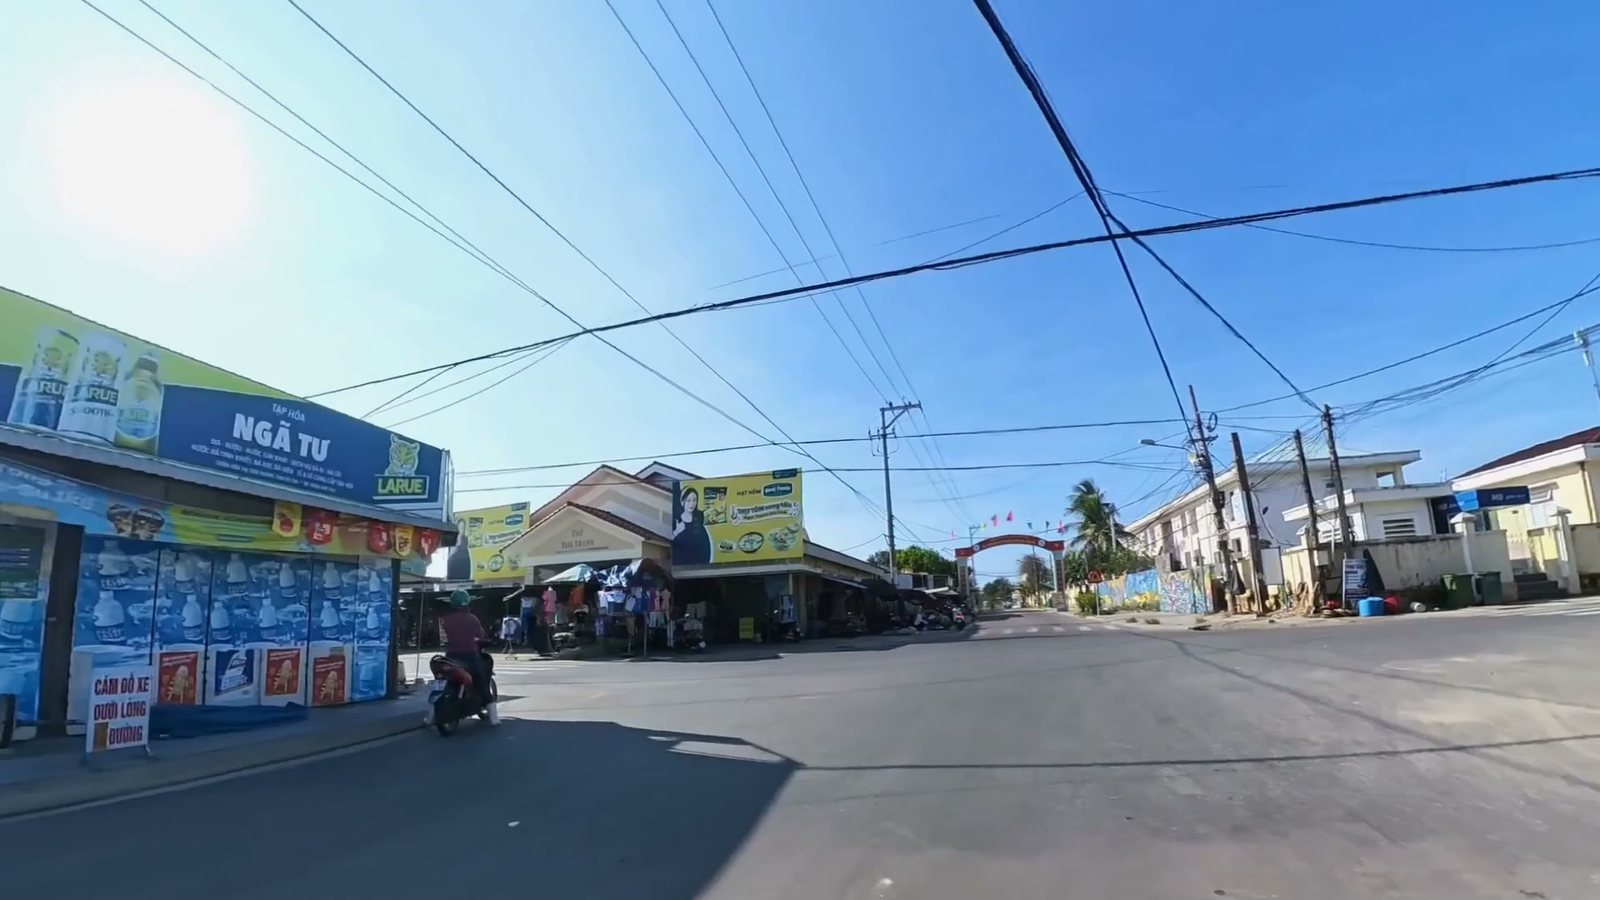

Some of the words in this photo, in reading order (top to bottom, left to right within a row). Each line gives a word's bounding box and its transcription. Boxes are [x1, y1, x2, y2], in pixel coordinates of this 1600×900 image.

[272, 403, 287, 416] TẠP
[288, 409, 305, 422] HÓA
[232, 412, 291, 453] NGÃ
[298, 432, 331, 462] TƯ
[377, 477, 424, 495] LARUE
[136, 676, 150, 693] XE
